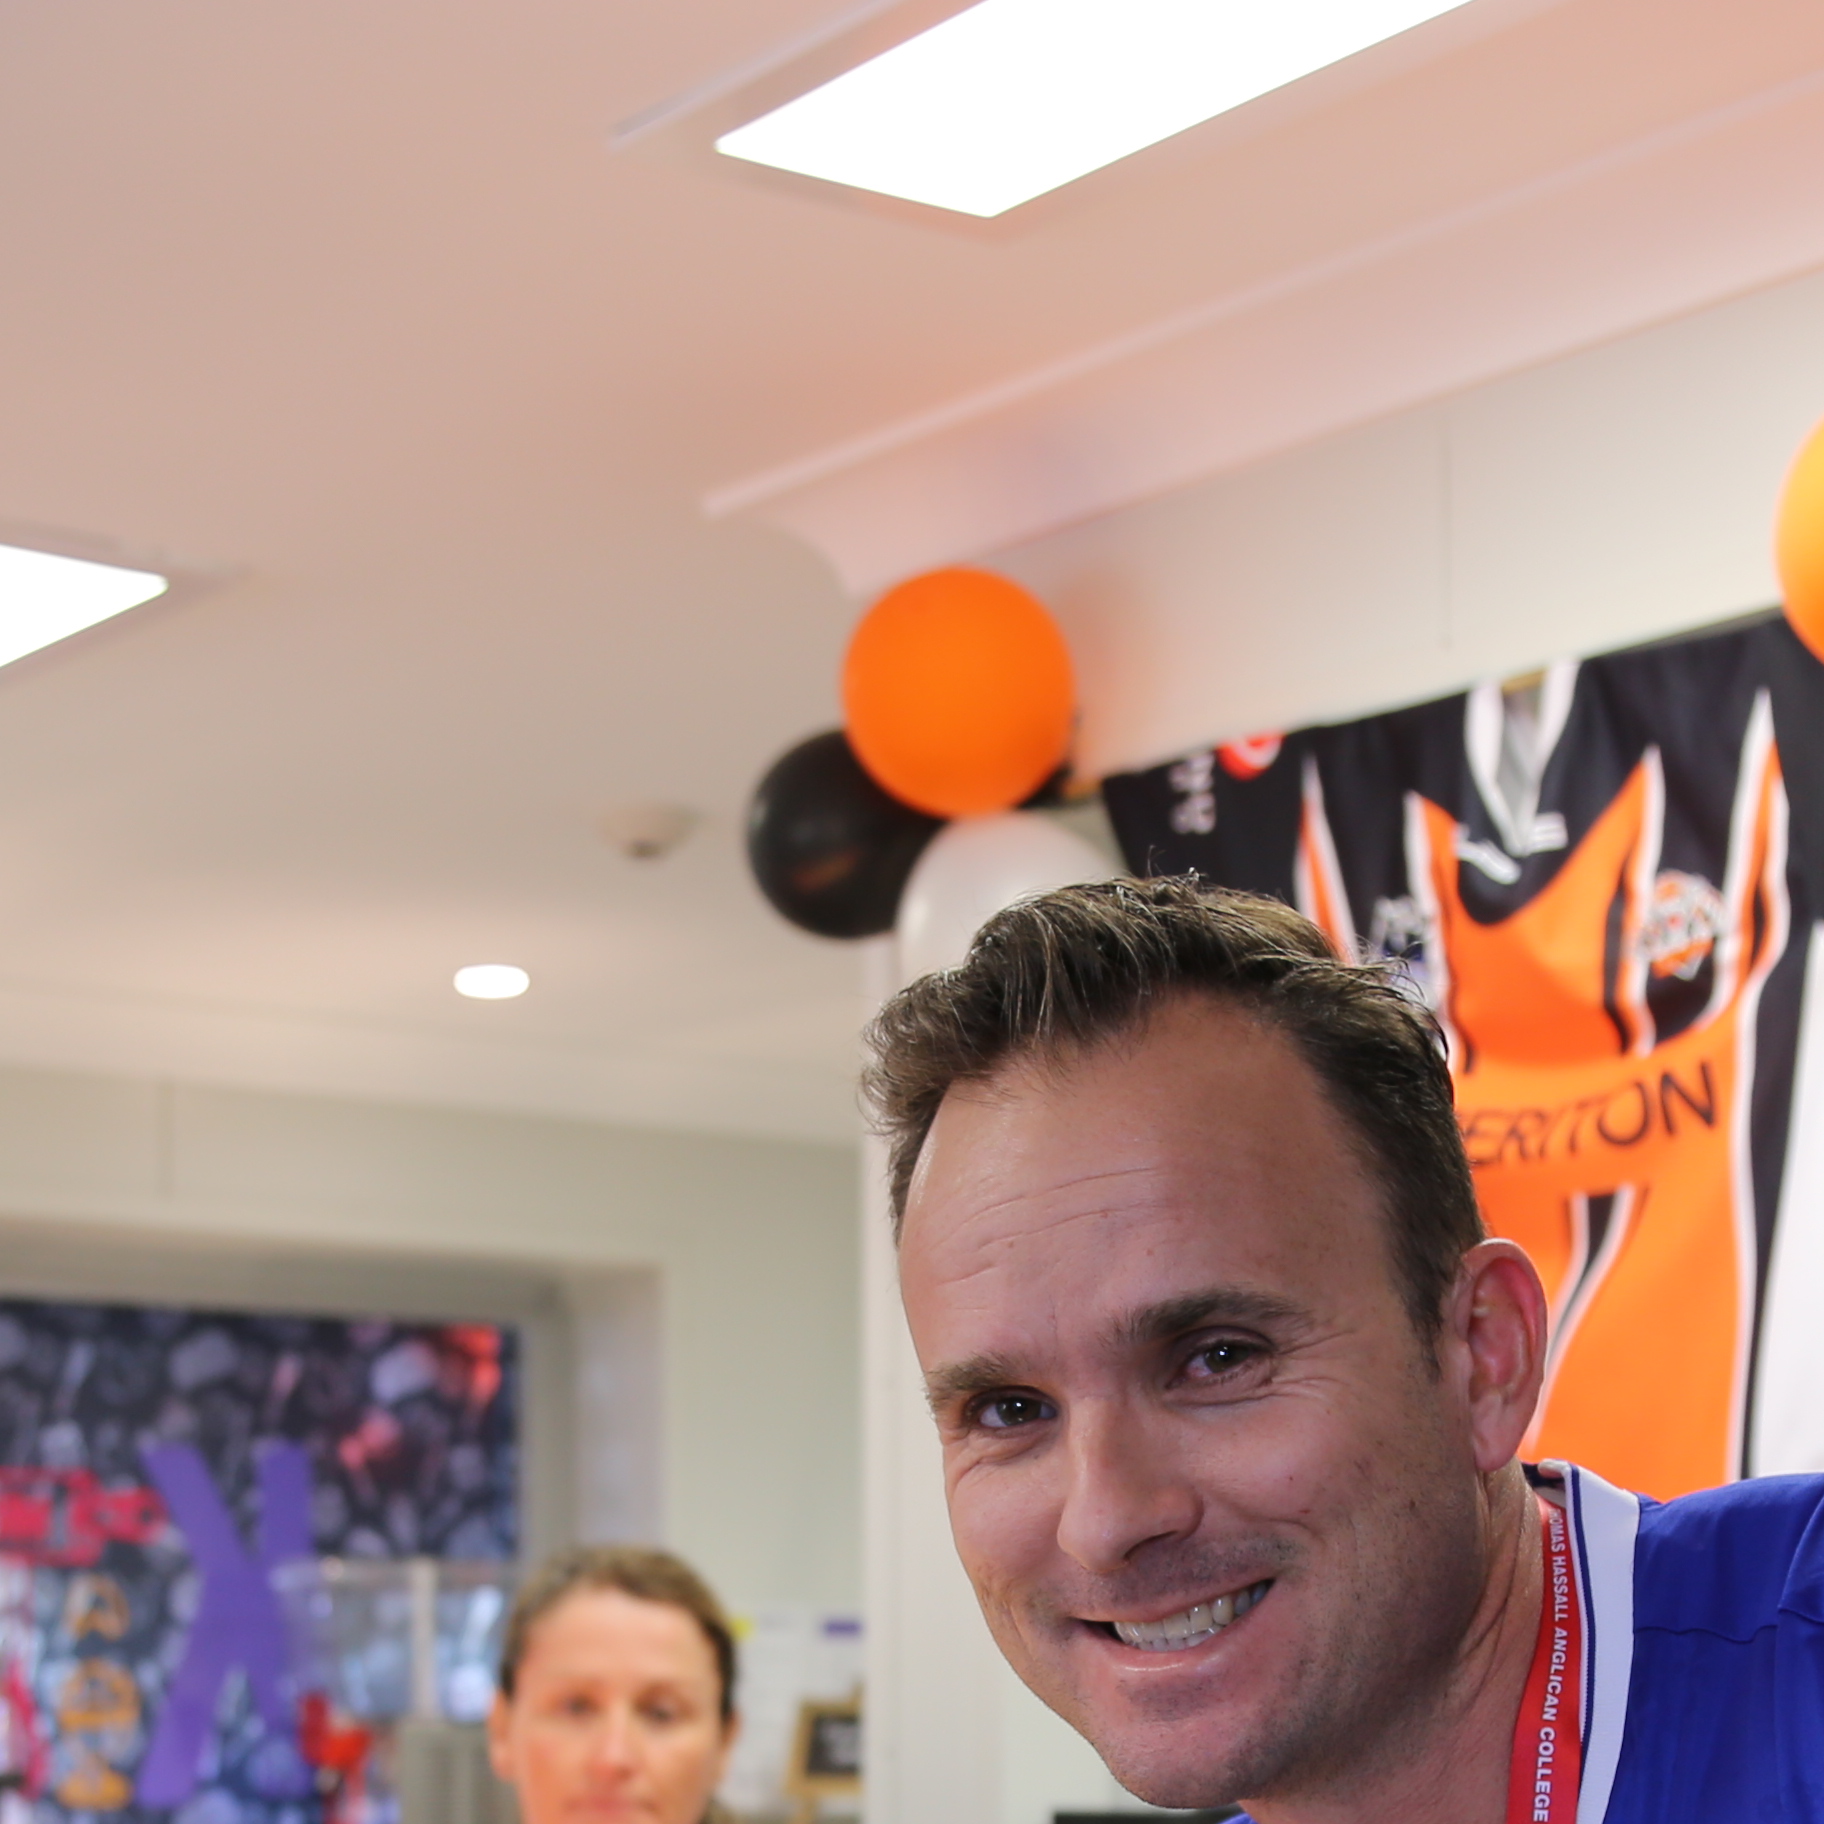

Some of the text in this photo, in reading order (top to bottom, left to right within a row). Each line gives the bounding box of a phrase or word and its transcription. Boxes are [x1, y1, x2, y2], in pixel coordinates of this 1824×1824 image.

[1552, 1555, 1568, 1622] HASSALL
[1542, 1626, 1564, 1721] ANGLICAN
[1533, 1727, 1555, 1822] COLLEGE
